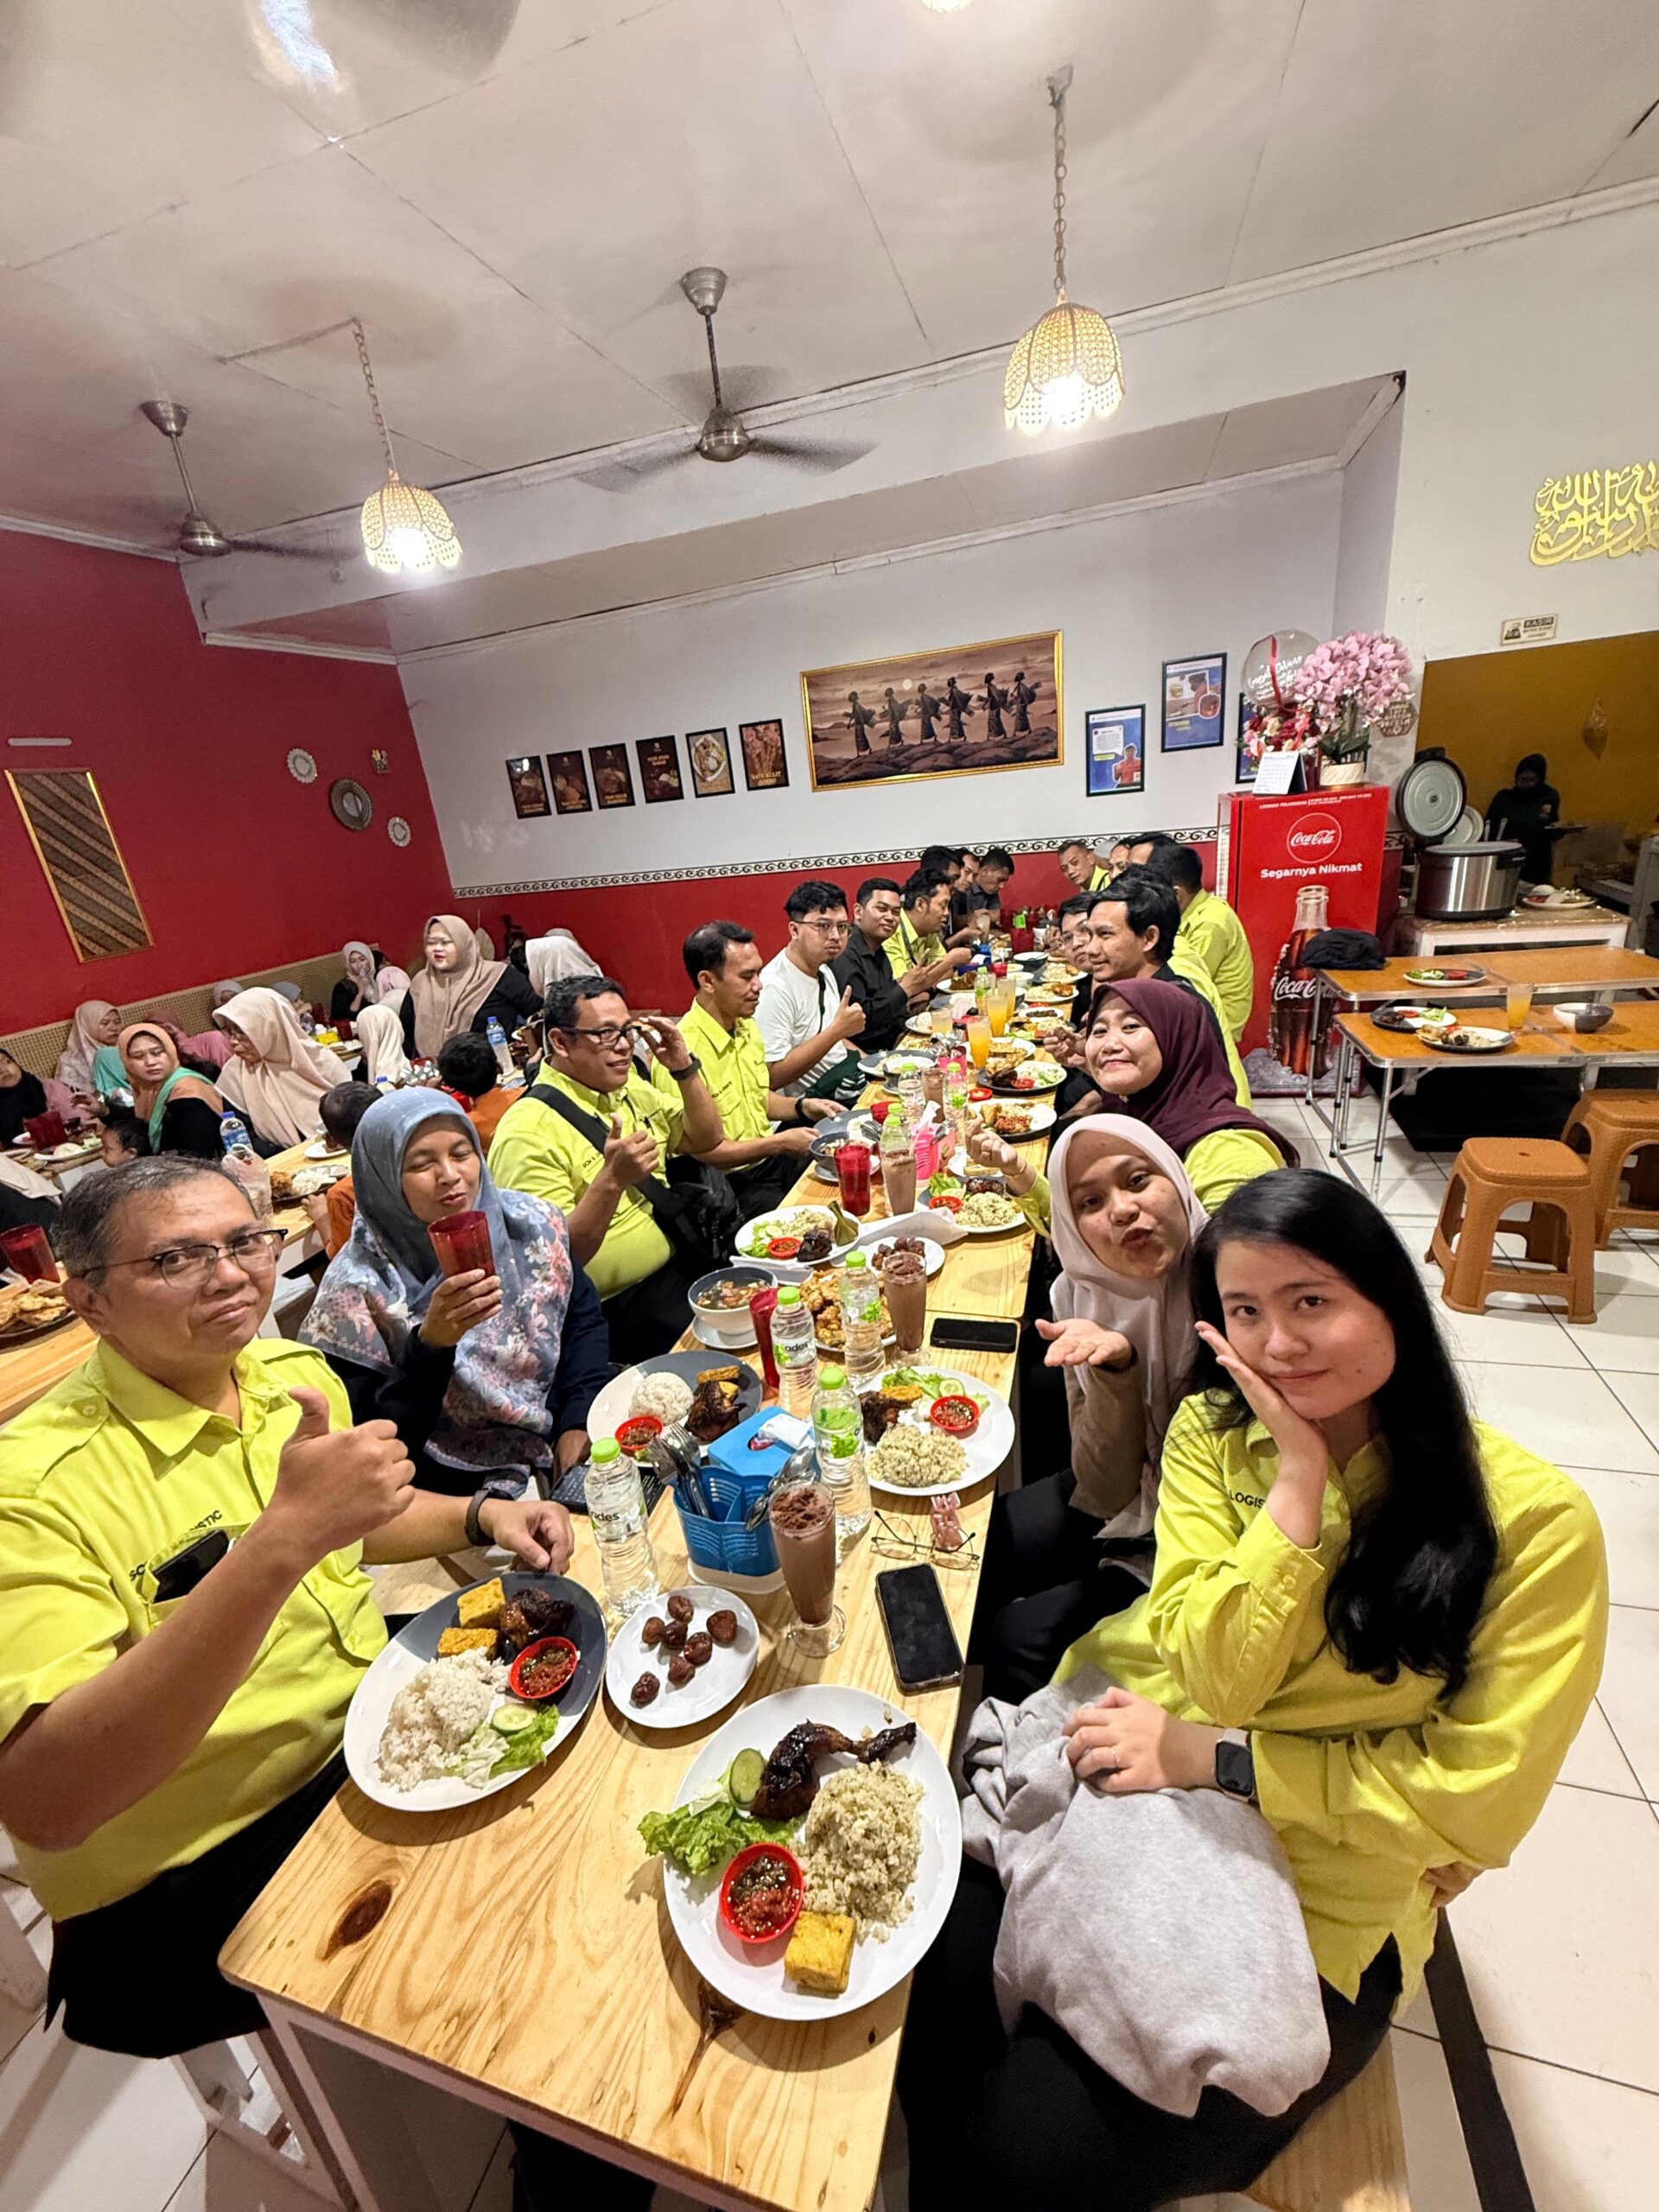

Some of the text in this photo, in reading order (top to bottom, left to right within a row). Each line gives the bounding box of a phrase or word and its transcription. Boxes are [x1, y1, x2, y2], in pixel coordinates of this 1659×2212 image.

[1525, 617, 1554, 627] KASIR
[1291, 830, 1337, 847] Coca-Cola
[1261, 862, 1363, 880] Segarnya Nikmat
[785, 1342, 809, 1352] ades
[1230, 1490, 1266, 1509] LOGIS
[590, 1510, 620, 1522] ades
[130, 1561, 148, 1581] SC
